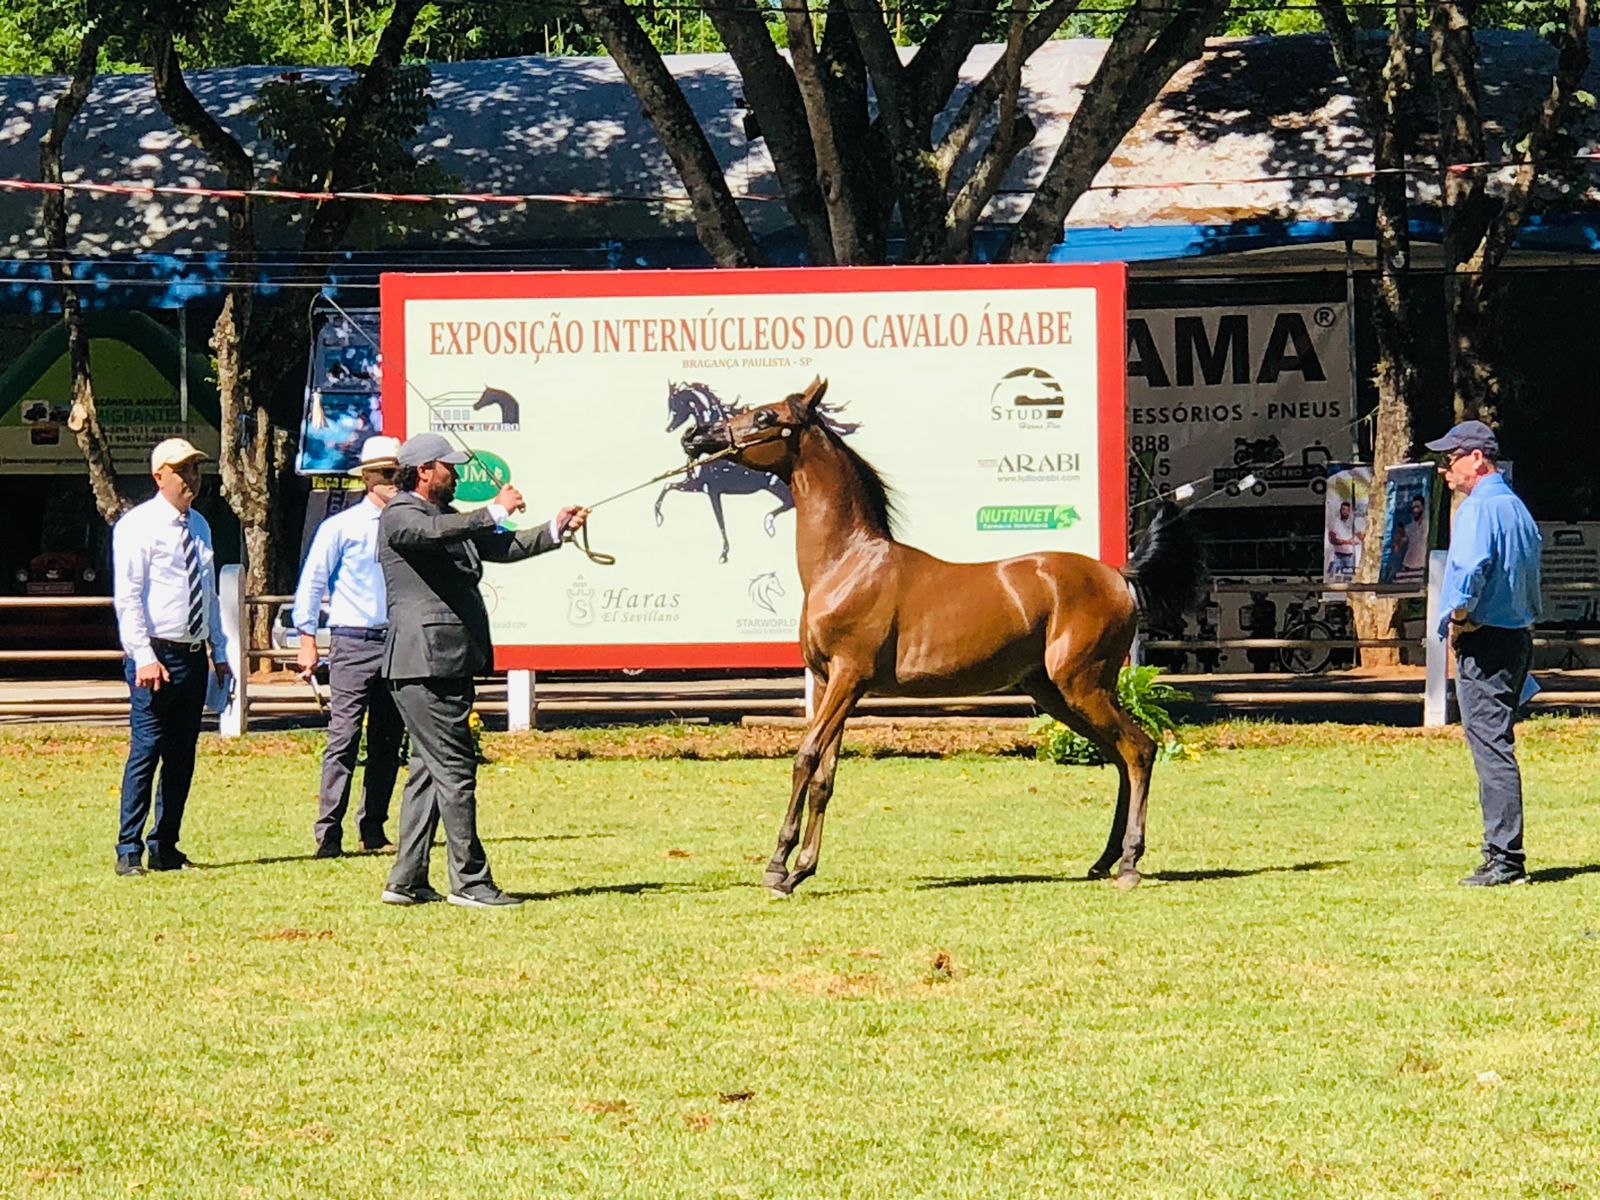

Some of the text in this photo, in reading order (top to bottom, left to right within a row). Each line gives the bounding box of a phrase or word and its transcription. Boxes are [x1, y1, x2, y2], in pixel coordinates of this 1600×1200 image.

[430, 303, 1073, 364] EXPOSIÇÃO INTERNÚCLEOS DO CAVALO ÁRABE
[682, 358, 740, 370] BRAGANÇA
[742, 357, 792, 368] PAULISTA
[799, 357, 813, 367] SP
[1267, 401, 1341, 420] PNEUS
[997, 453, 1080, 473] ARABI
[979, 508, 1053, 523] NUTRIVET
[601, 587, 681, 610] Haras
[601, 610, 681, 623] El Sevillano
[735, 618, 798, 629] STARWORLD
